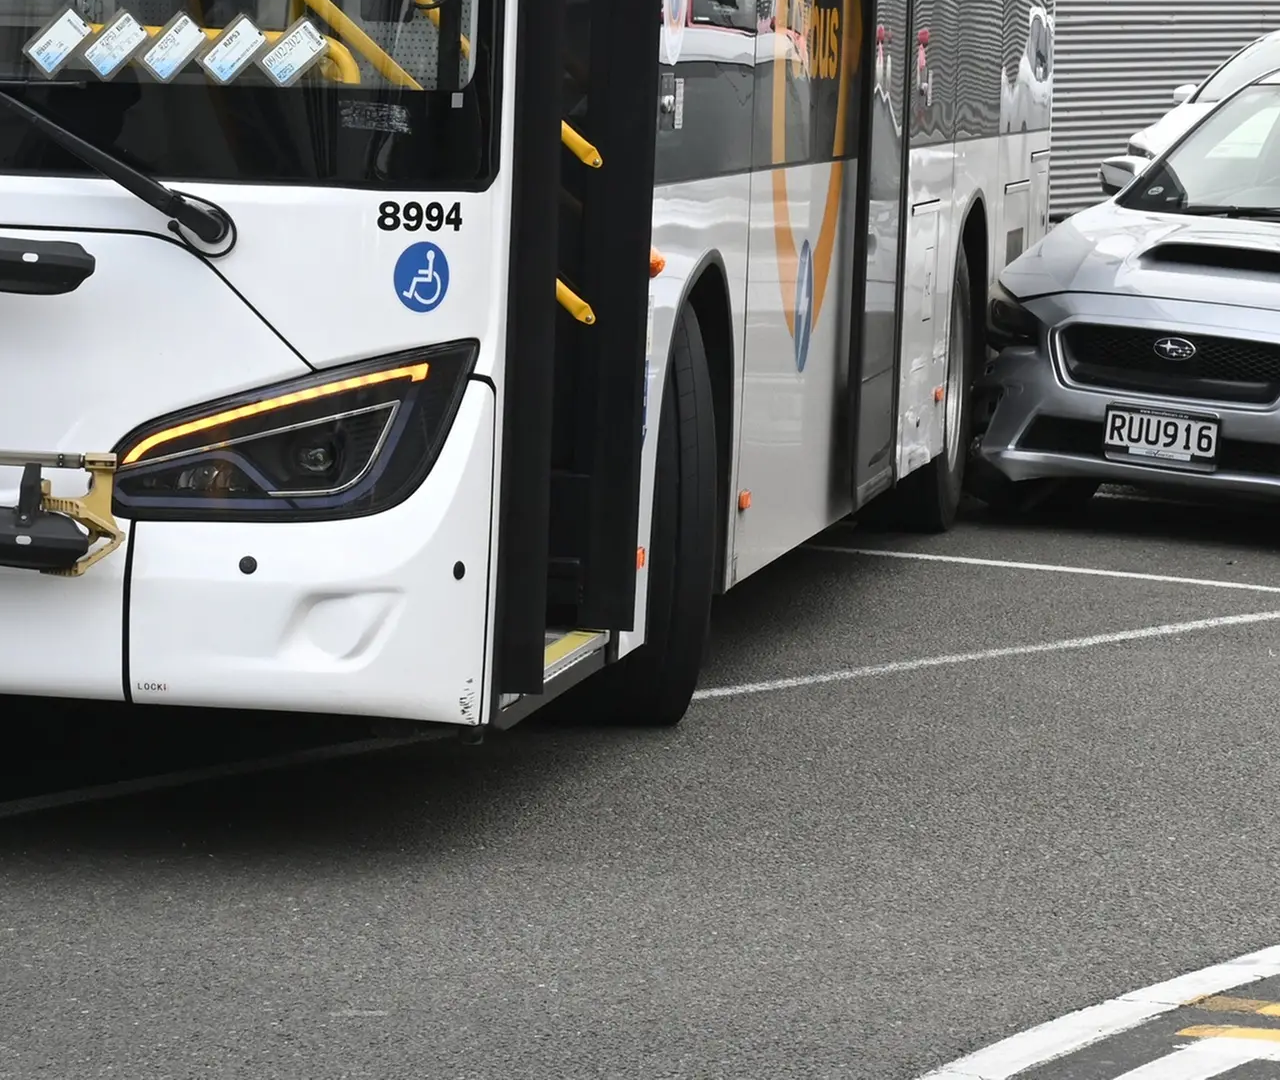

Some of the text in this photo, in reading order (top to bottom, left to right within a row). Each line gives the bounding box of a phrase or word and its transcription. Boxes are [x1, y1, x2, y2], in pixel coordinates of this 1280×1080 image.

[265, 31, 304, 68] 09/02/2027
[377, 200, 463, 232] 8994
[1109, 413, 1213, 453] RUU916
